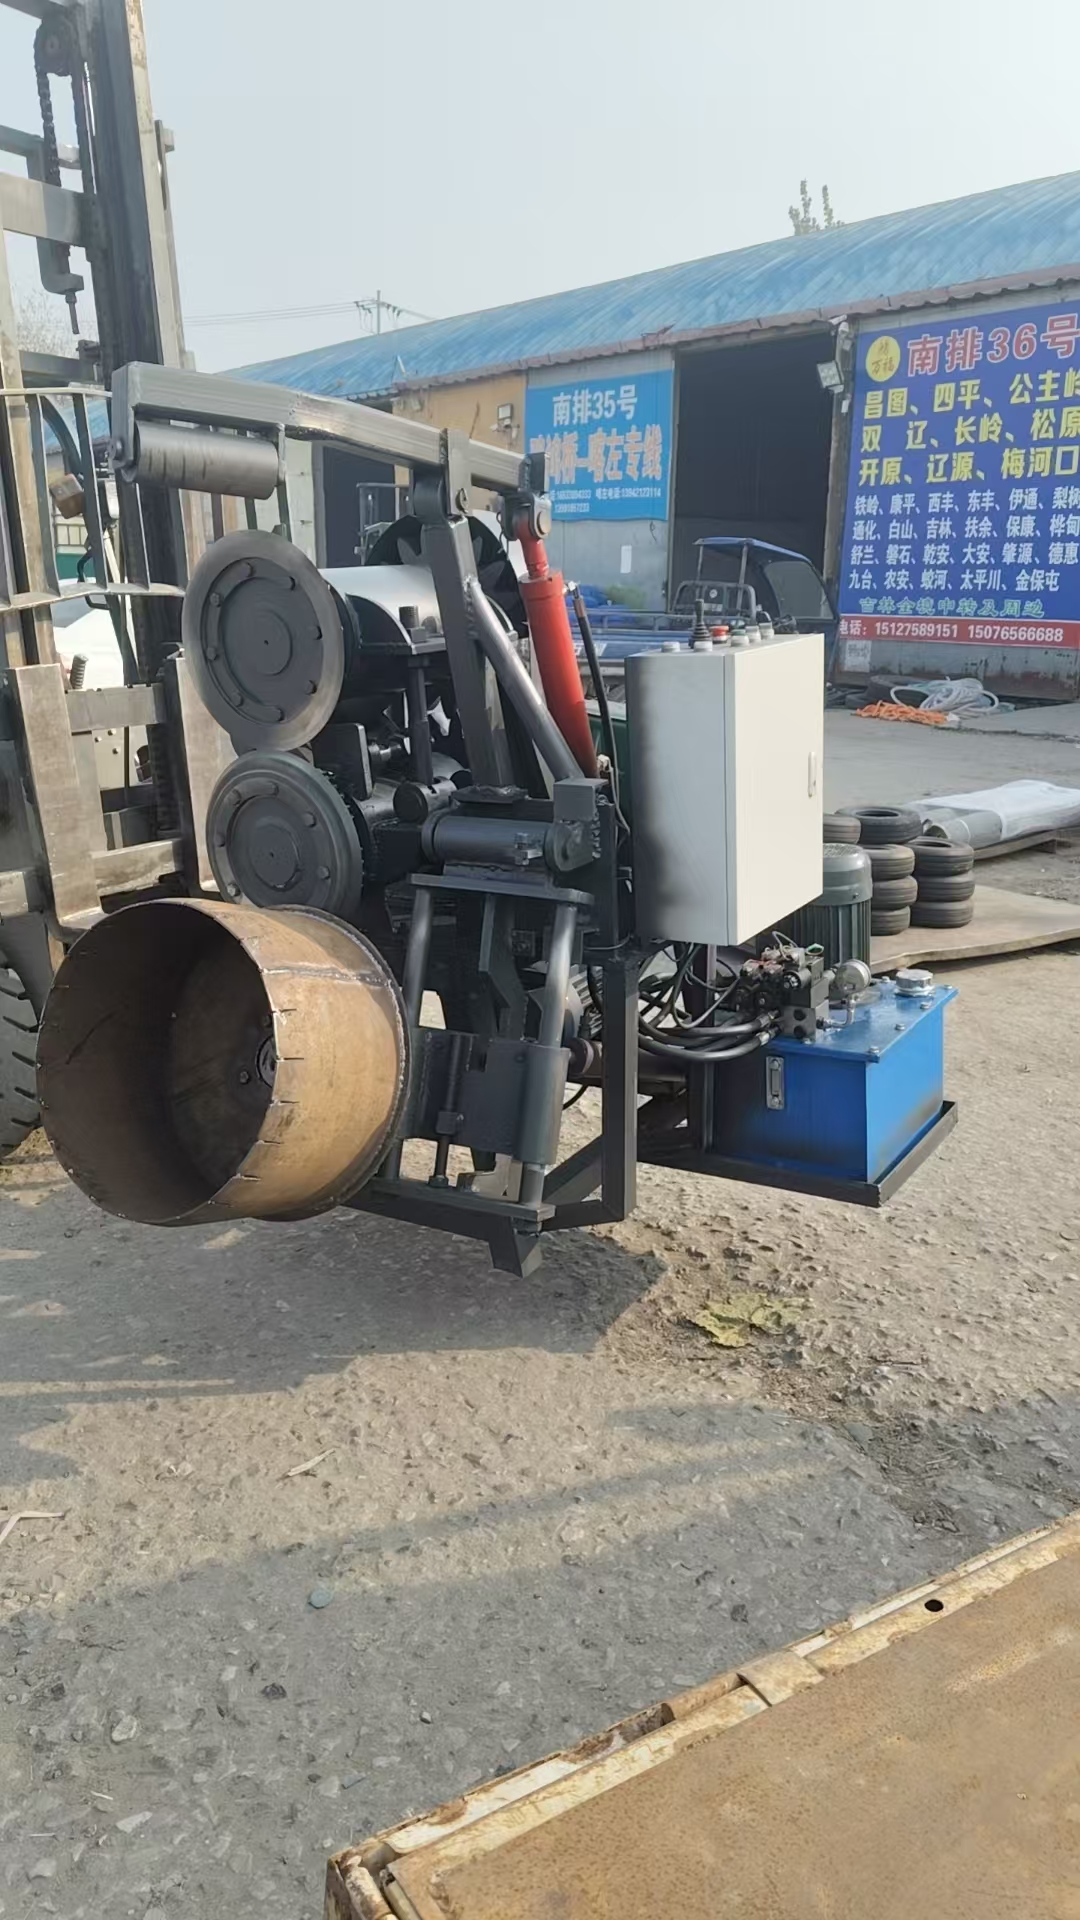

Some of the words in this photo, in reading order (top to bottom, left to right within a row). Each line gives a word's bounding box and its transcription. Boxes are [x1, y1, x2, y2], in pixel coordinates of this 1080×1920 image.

[907, 313, 1080, 377] 南排36号
[552, 384, 638, 427] 南排35号
[875, 621, 958, 639] 15127589151
[967, 624, 1064, 643] 15076566688
